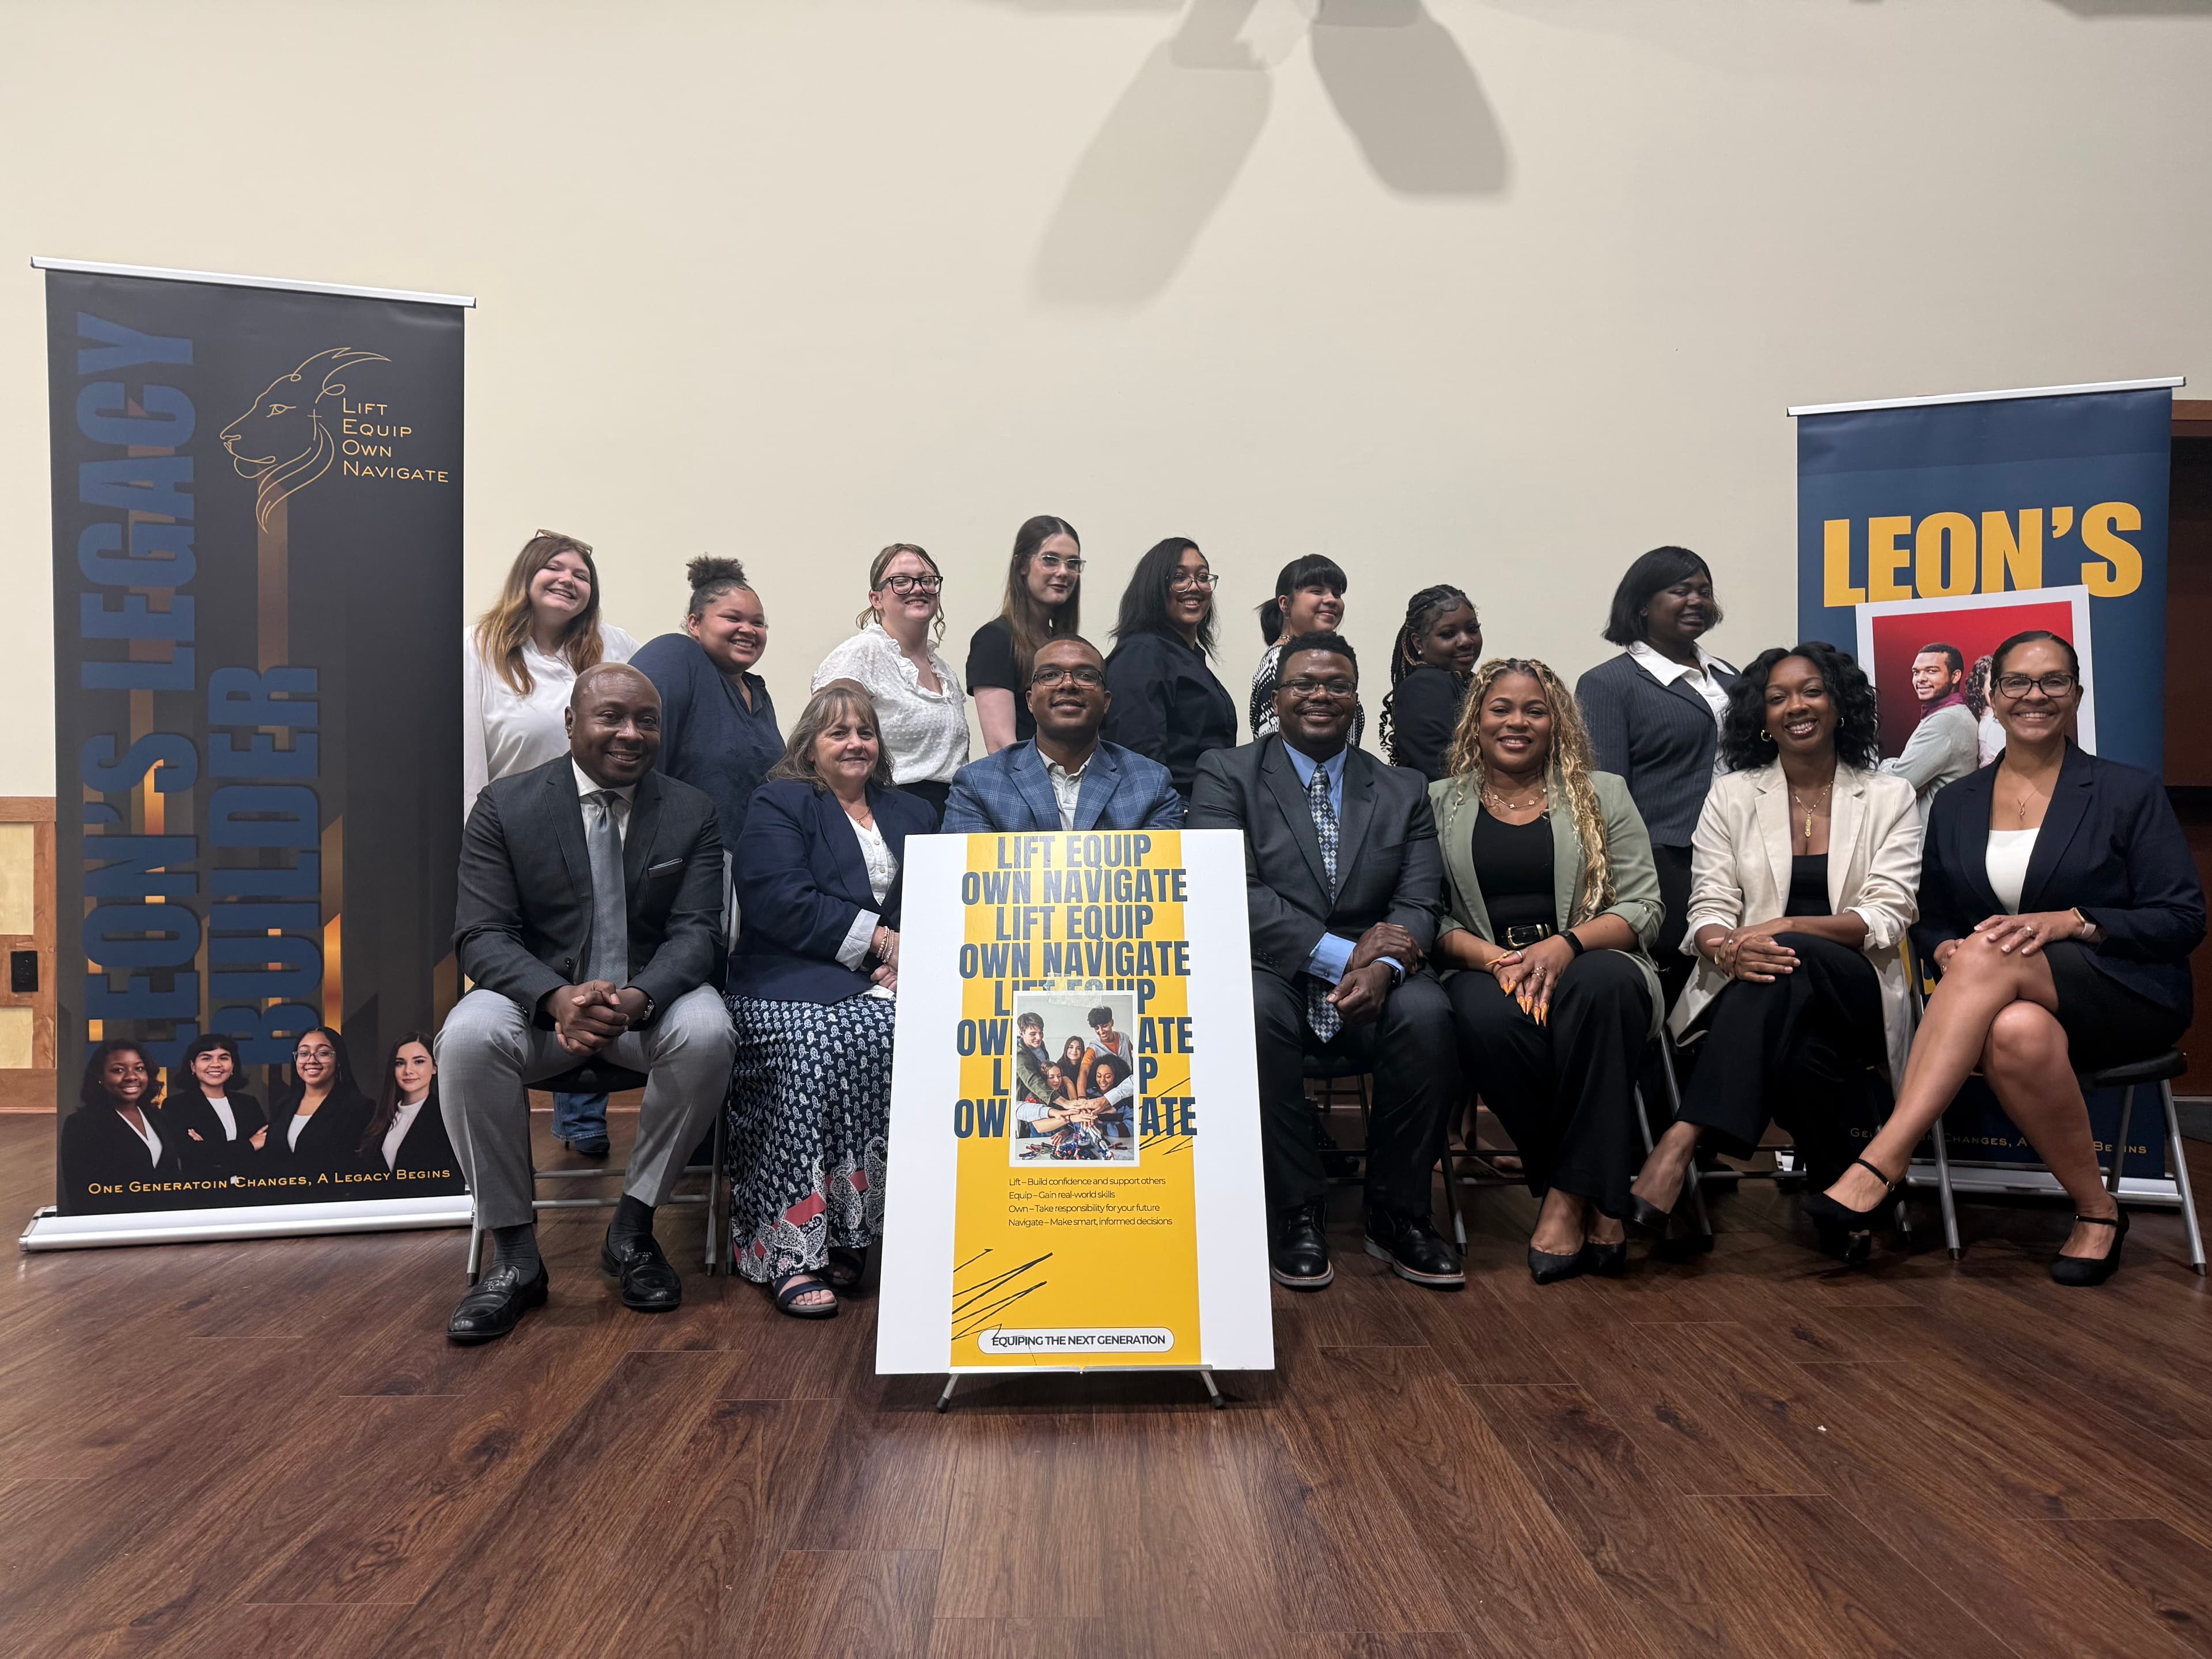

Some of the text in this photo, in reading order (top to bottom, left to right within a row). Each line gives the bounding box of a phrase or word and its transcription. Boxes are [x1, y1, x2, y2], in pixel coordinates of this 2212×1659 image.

[343, 397, 388, 415] LIFT
[343, 418, 412, 438] EQUIP
[342, 439, 392, 457] OWN
[343, 460, 449, 483] NAVIGATE
[77, 311, 197, 690] LEGACY
[1824, 501, 2142, 607] LEON'S
[997, 834, 1152, 870] LIFT EQUIP
[208, 666, 323, 1065] BUILDER
[961, 868, 1188, 905] OWN NAVIGATE
[995, 904, 1154, 942] LIFT EQUIP
[959, 941, 1191, 979] OWN NAVIGATE
[957, 1019, 1012, 1056] OW
[953, 1099, 1010, 1138] OW
[2093, 1141, 2147, 1154] BEINS
[88, 1169, 450, 1194] ONE GENERATOIN CHANGES, A LEGACY BEGINS
[1009, 1177, 1021, 1186] Lift
[1027, 1177, 1048, 1185] Build
[1048, 1177, 1092, 1185] confidence
[1093, 1177, 1108, 1185] and
[1109, 1177, 1141, 1186] support
[1141, 1177, 1166, 1185] others
[1009, 1191, 1032, 1200] Equip
[1039, 1191, 1056, 1199] Gain
[1058, 1191, 1096, 1199] real-world
[1097, 1190, 1115, 1198] skills
[1035, 1204, 1054, 1212] Take
[1055, 1203, 1105, 1213] responsibility
[1105, 1203, 1117, 1211] for
[1117, 1205, 1135, 1213] your
[1136, 1203, 1160, 1211] future
[1009, 1218, 1044, 1228] Navigate
[1050, 1217, 1072, 1226] Make
[1073, 1217, 1098, 1226] smart,
[1099, 1217, 1135, 1225] informed
[1137, 1217, 1173, 1225] decisions
[992, 1335, 1165, 1347] EQUIPING THE NEXT GENERATION
